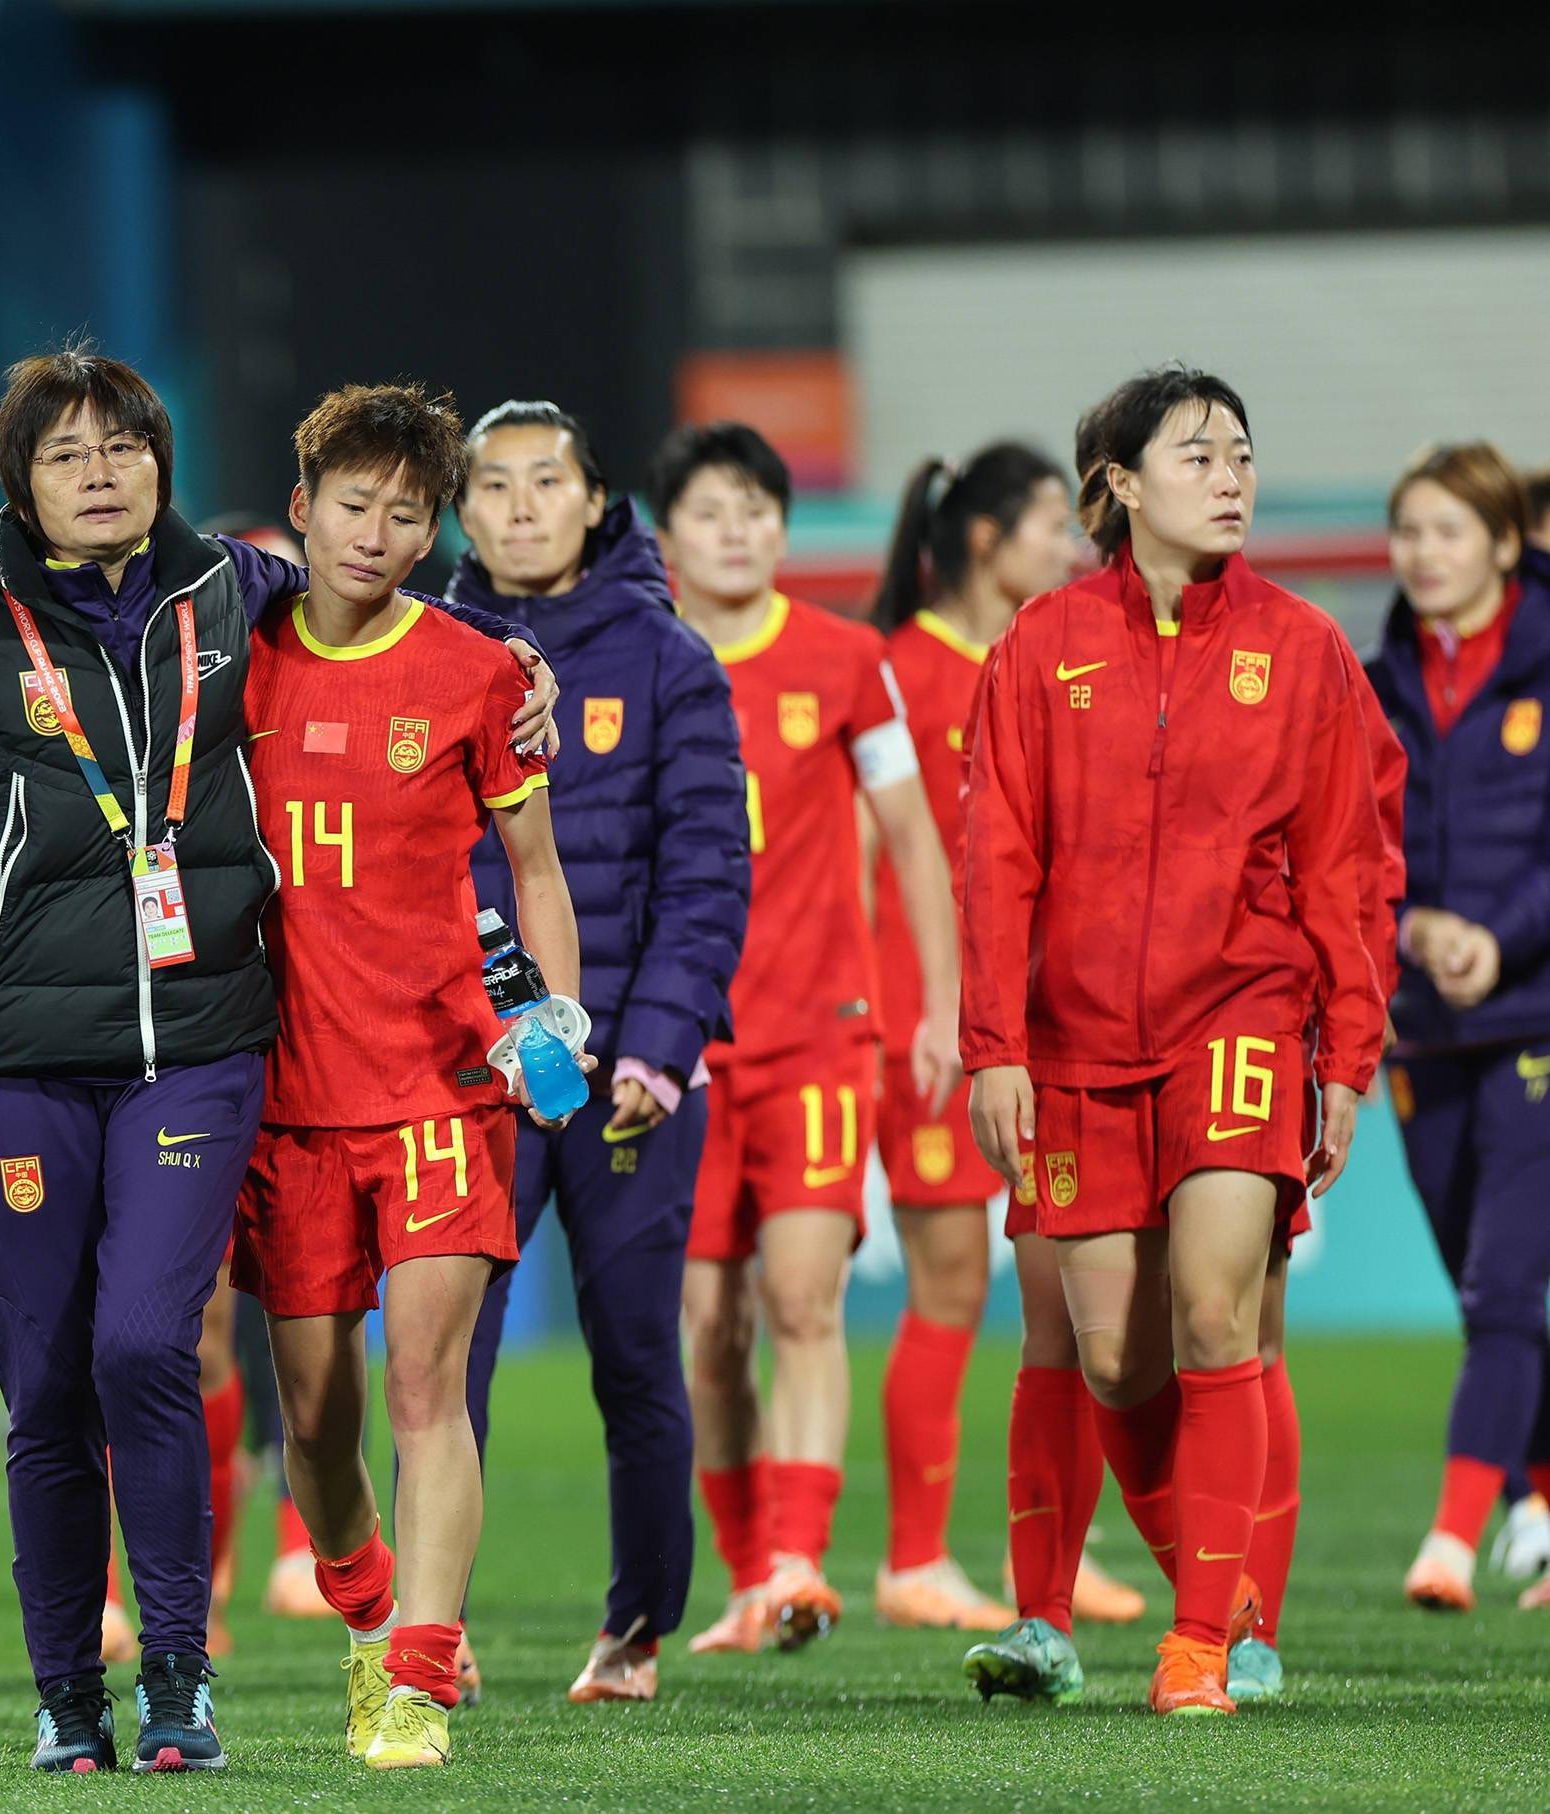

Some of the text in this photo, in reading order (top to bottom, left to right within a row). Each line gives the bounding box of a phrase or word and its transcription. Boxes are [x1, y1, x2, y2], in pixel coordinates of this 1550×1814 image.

[18, 611, 35, 640] WORLD
[30, 639, 43, 659] CUP
[49, 686, 68, 713] 2023
[197, 652, 220, 668] NIKE
[1069, 684, 1092, 709] 22
[393, 721, 426, 734] CFA
[285, 800, 354, 888] 14
[481, 964, 520, 987] ERADE
[1208, 1035, 1276, 1122] 16
[799, 1084, 857, 1168] 11
[5, 1160, 36, 1173] CFA
[157, 1151, 201, 1169] SHUI Q X
[398, 1117, 468, 1202] 14
